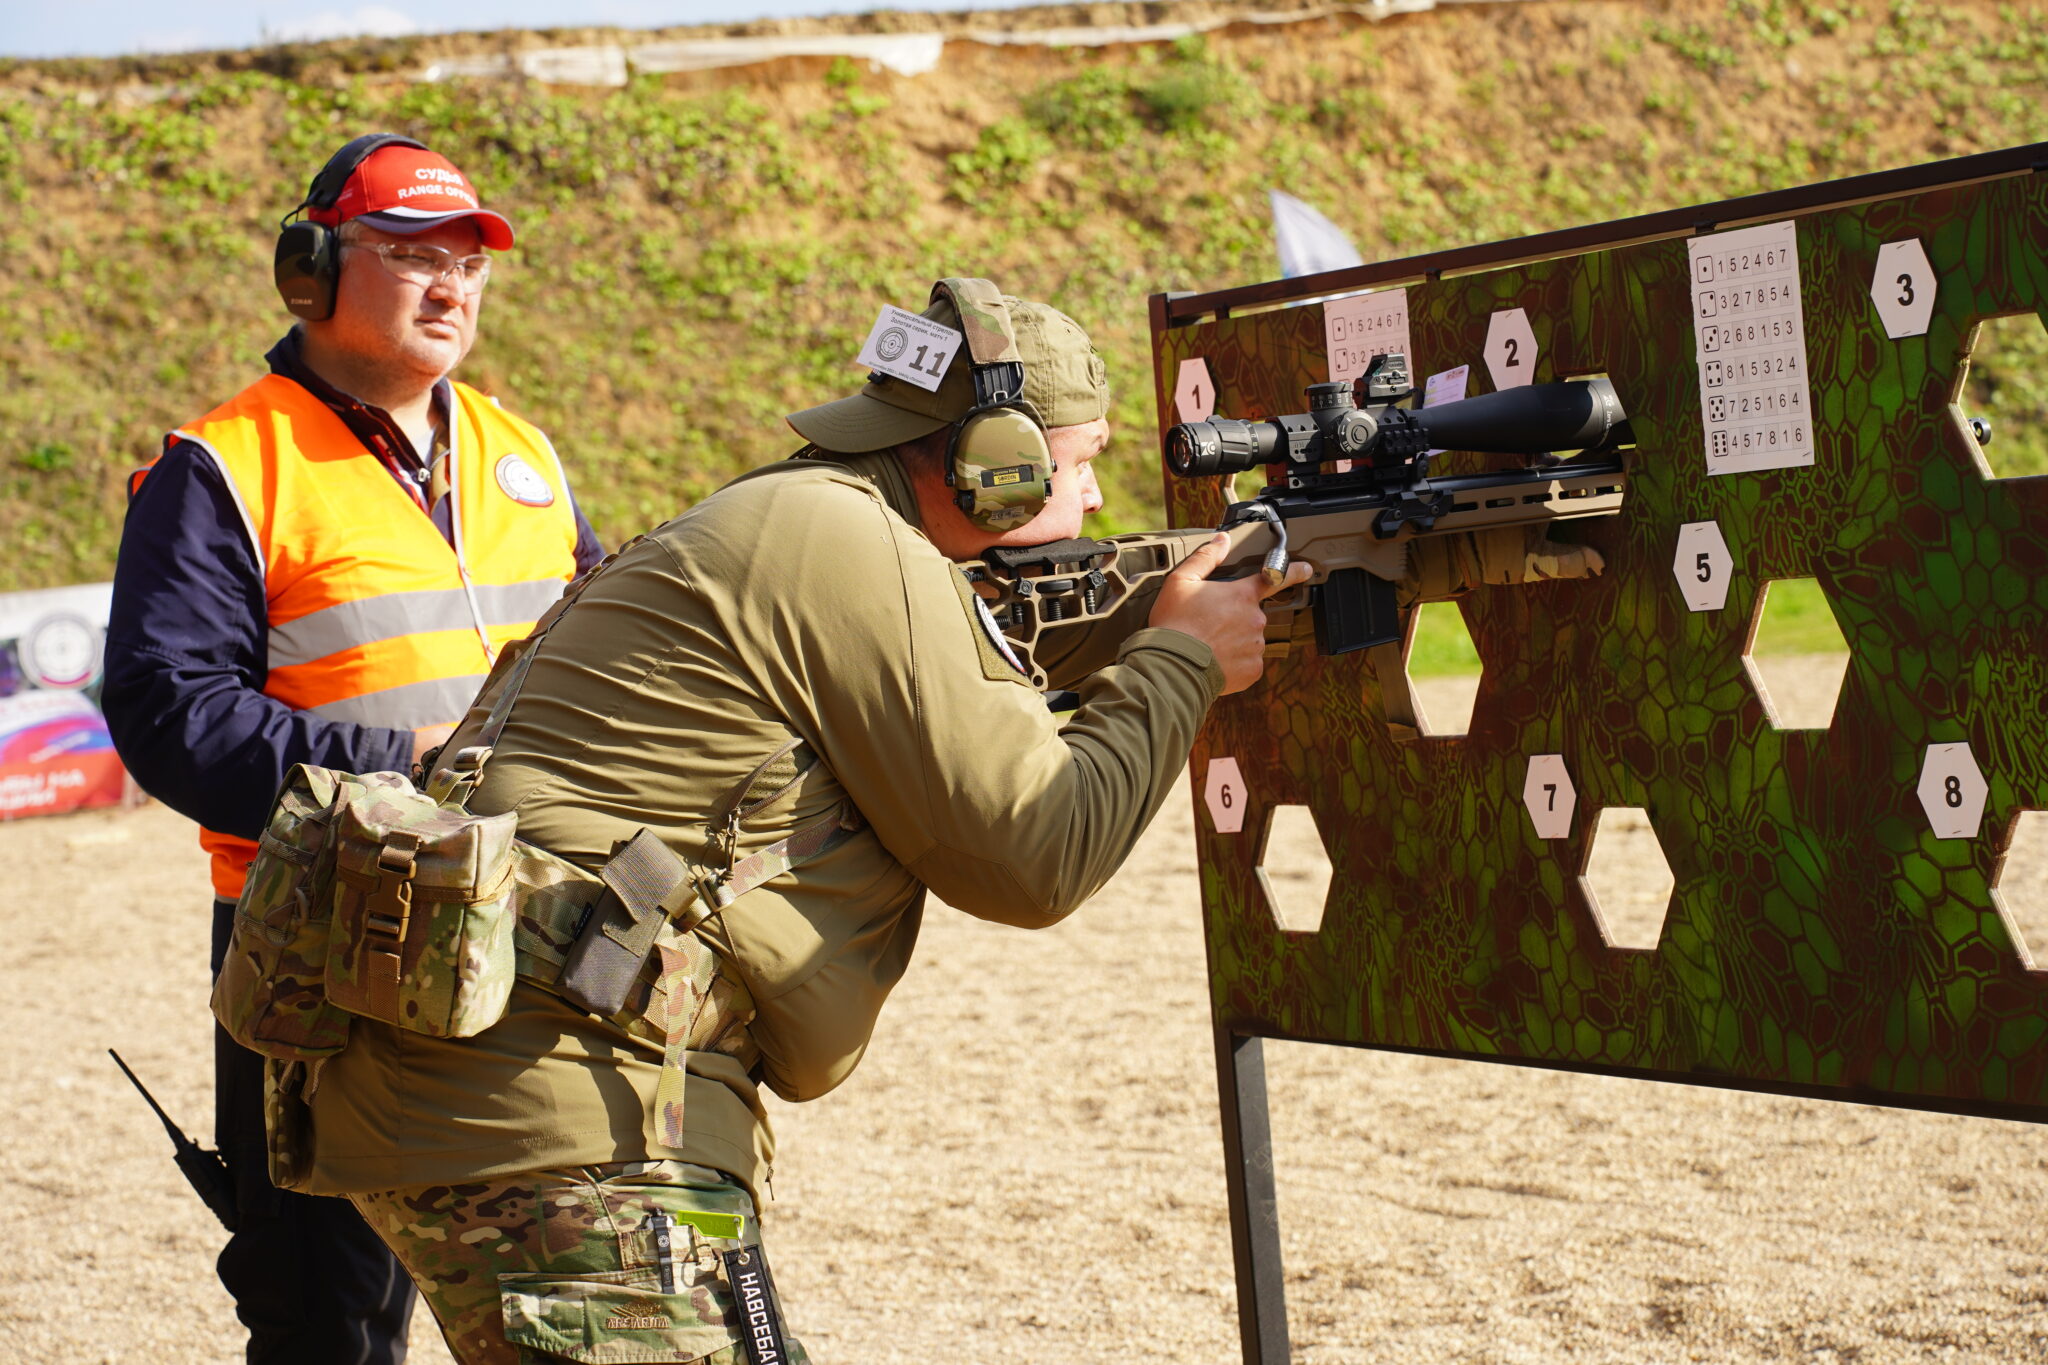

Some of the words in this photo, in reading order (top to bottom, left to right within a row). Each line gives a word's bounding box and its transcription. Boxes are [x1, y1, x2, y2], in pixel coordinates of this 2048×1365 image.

[397, 184, 444, 200] RANGE
[1718, 260, 1723, 274] 1
[1730, 257, 1737, 272] 5
[1742, 255, 1749, 270] 2
[1754, 253, 1762, 268] 4
[1767, 251, 1774, 266] 6
[1779, 248, 1786, 264] 7
[1720, 295, 1728, 309] 3
[1732, 292, 1740, 308] 2
[1744, 291, 1752, 305] 7
[1757, 288, 1765, 304] 8
[1770, 286, 1777, 301] 5
[1782, 284, 1790, 299] 4
[1896, 272, 1915, 307] 3
[891, 308, 932, 328] Универсальный
[932, 324, 954, 336] стрелок
[891, 316, 912, 328] Золотая
[929, 331, 943, 340] матч
[1348, 321, 1354, 333] 1
[1358, 319, 1364, 333] 5
[1367, 317, 1373, 331] 2
[1376, 316, 1383, 329] 4
[1386, 314, 1392, 328] 6
[1396, 312, 1402, 326] 7
[1723, 330, 1730, 344] 2
[1735, 328, 1743, 342] 6
[1748, 326, 1755, 340] 8
[1761, 324, 1767, 338] 1
[1773, 322, 1780, 337] 5
[1785, 320, 1793, 335] 3
[908, 344, 946, 378] 11
[1350, 352, 1357, 364] 3
[1360, 350, 1366, 364] 2
[1504, 338, 1520, 368] 2
[1726, 365, 1734, 379] 8
[1739, 363, 1745, 377] 1
[1751, 361, 1758, 376] 5
[1763, 359, 1771, 374] 3
[1776, 358, 1784, 372] 2
[1788, 356, 1796, 370] 4
[1191, 384, 1201, 410] 1
[1729, 400, 1736, 414] 7
[1741, 398, 1749, 413] 2
[1754, 396, 1762, 411] 5
[1767, 395, 1773, 409] 1
[1779, 393, 1786, 408] 6
[1792, 392, 1799, 406] 4
[1732, 435, 1738, 448] 4
[1743, 433, 1751, 448] 5
[1756, 432, 1763, 446] 7
[1769, 430, 1777, 445] 8
[1783, 429, 1788, 443] 1
[1795, 427, 1802, 442] 6
[1696, 552, 1712, 583] 5
[1220, 783, 1233, 810] 6
[1542, 783, 1557, 812] 7
[1944, 775, 1963, 808] 8
[739, 1271, 780, 1365] НАВСЕБА
